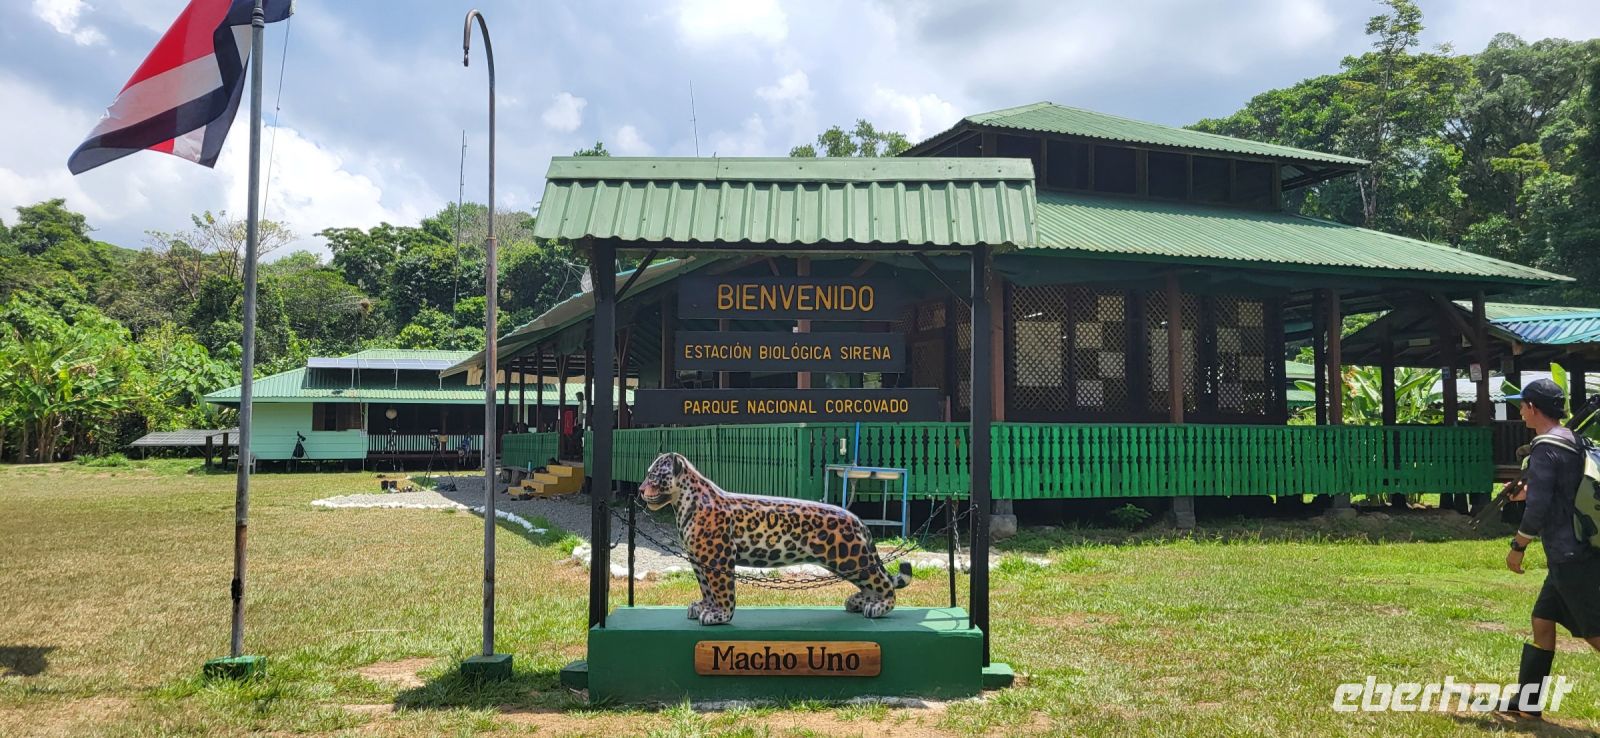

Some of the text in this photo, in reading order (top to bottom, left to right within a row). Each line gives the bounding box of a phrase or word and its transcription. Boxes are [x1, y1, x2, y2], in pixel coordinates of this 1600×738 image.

[717, 284, 875, 312] BIENVENIDO
[684, 342, 891, 360] ESTACIÓN BIOLÓGICA SIRENA
[684, 399, 909, 414] PARQUE NACIONAL CORCOVADO
[711, 645, 860, 671] Macho Uno
